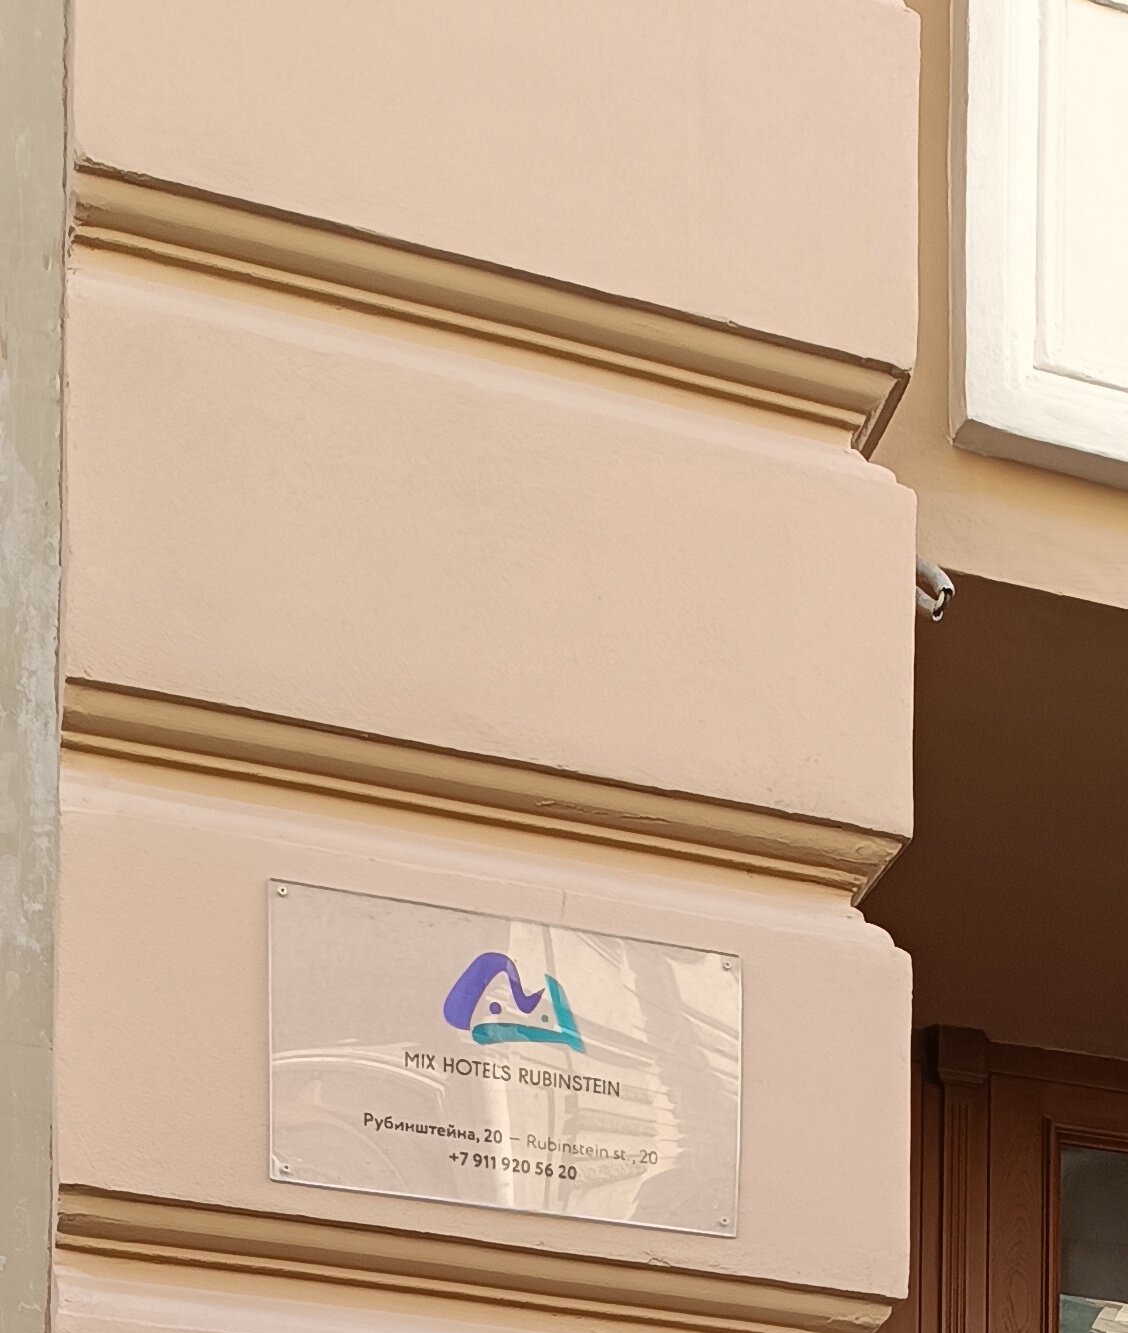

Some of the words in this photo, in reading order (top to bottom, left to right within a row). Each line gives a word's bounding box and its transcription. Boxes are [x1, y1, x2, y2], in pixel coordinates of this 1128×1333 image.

[404, 1051, 436, 1071] MIX
[443, 1058, 511, 1081] HOTELS
[518, 1068, 621, 1097] RUBINSTEIN
[363, 1112, 481, 1143] Рубинштейна,
[484, 1129, 503, 1144] 20
[526, 1134, 609, 1159] Rubinstein
[639, 1150, 658, 1165] 20
[449, 1152, 469, 1166] +7
[473, 1154, 496, 1169] 911
[501, 1157, 531, 1174] 920
[534, 1162, 554, 1177] 56
[558, 1165, 578, 1180] 20
